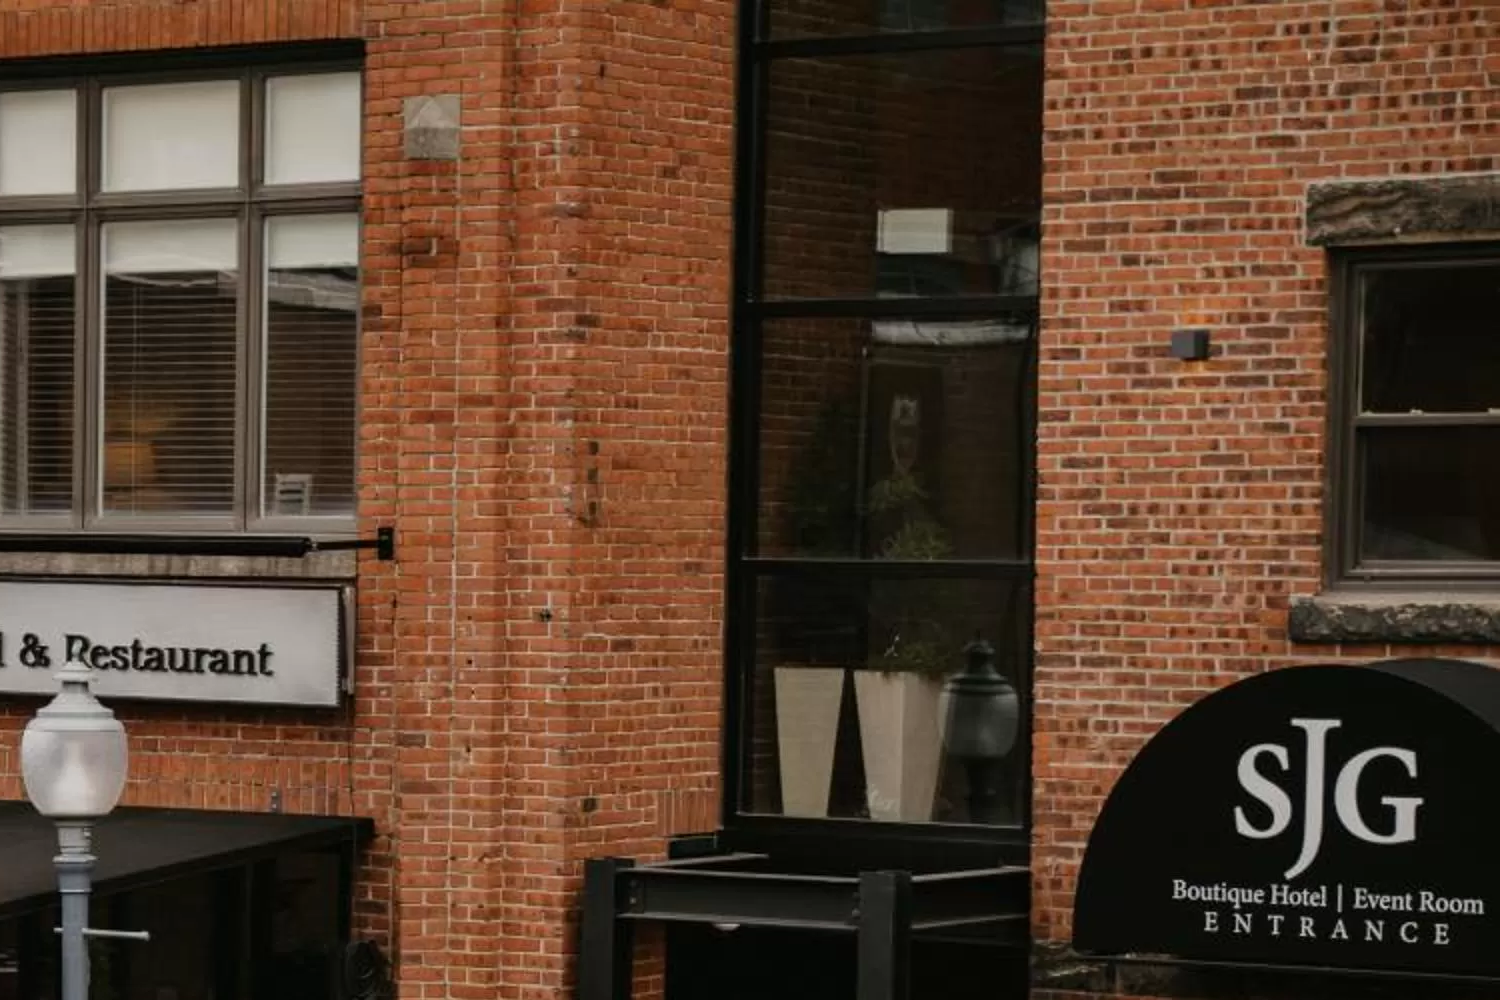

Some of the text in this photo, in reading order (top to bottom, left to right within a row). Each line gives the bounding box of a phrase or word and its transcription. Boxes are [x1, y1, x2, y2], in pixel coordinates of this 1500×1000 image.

[18, 632, 51, 668] &
[64, 633, 274, 677] Restaurant
[1233, 717, 1424, 881] SJG
[1172, 879, 1265, 909] Boutique
[1270, 884, 1328, 908] Hotel
[1352, 887, 1413, 912] Event
[1418, 890, 1485, 915] Room
[1203, 910, 1451, 946] ENTRANCE
